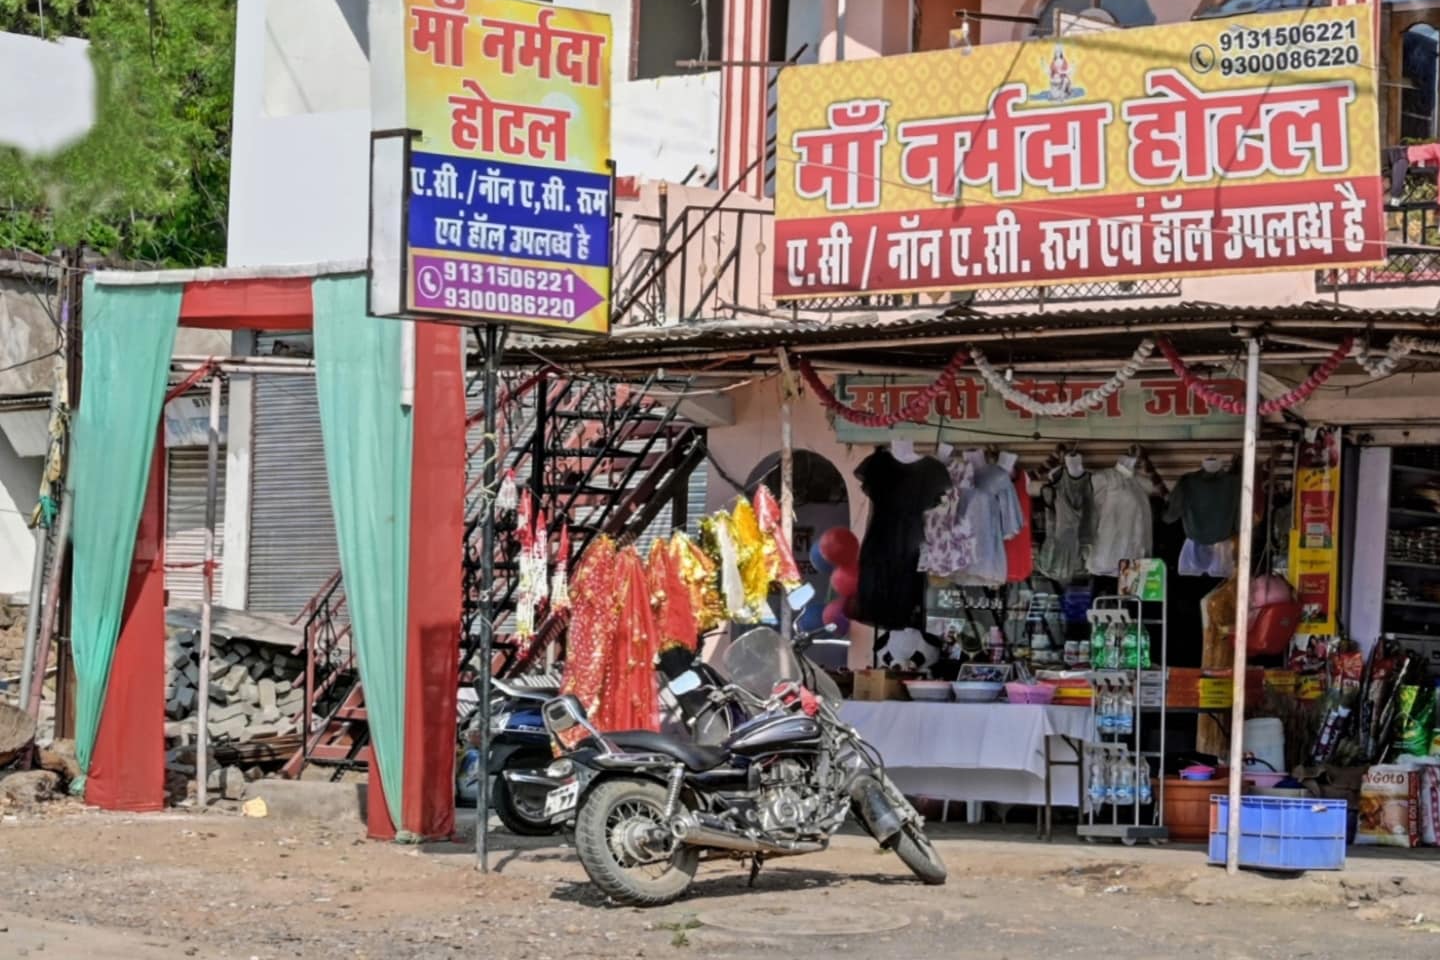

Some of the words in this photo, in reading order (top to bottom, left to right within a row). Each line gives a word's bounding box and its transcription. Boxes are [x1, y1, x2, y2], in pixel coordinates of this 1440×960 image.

[482, 10, 605, 86] नर्मदा
[1219, 20, 1358, 52] 9131506221
[1221, 45, 1360, 77] 9300086220
[448, 80, 571, 162] होटल
[898, 85, 1109, 201] नर्मदा
[1123, 70, 1356, 186] होटल
[576, 186, 608, 217] रूम
[435, 209, 464, 247] एवं
[468, 212, 506, 252] हॉल
[509, 225, 573, 258] उपलब्ध
[574, 223, 591, 260] है
[887, 215, 943, 280] नॉन
[1039, 217, 1091, 270] रूम
[1099, 197, 1144, 267] एवं
[1151, 194, 1215, 264] हॉल
[1221, 201, 1334, 260] उपलब्ध
[1334, 181, 1367, 253] है
[444, 261, 575, 293] 9131506221
[444, 288, 575, 318] 9300086220
